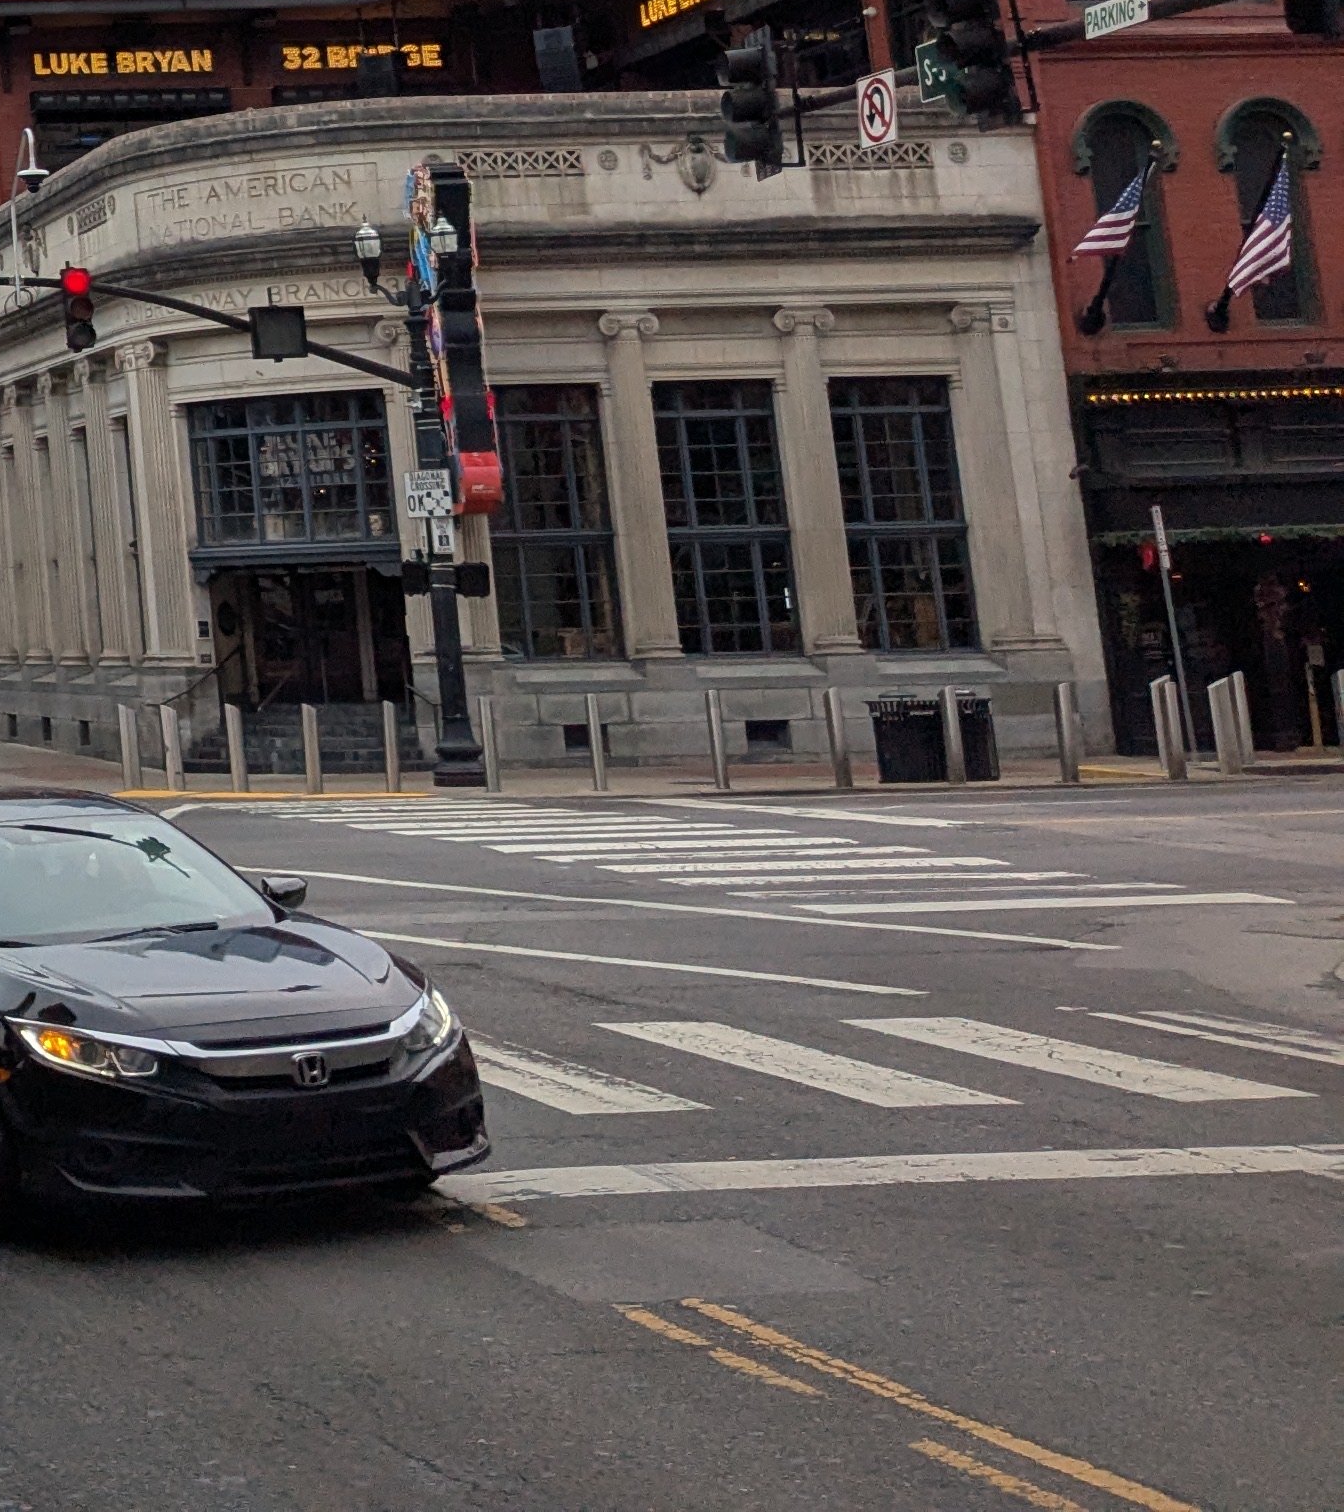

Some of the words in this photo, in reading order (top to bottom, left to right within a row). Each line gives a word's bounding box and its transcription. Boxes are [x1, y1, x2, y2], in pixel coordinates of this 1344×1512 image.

[33, 51, 109, 76] LUKE
[115, 48, 213, 75] BRYAN
[281, 45, 323, 70] 32
[326, 44, 443, 69] BRGE
[148, 187, 189, 214] THE
[205, 168, 352, 204] AMERICAN
[149, 210, 266, 242] NATIONAL
[277, 201, 359, 228] BANK
[411, 480, 446, 492] CROSSING
[407, 494, 426, 512] OK
